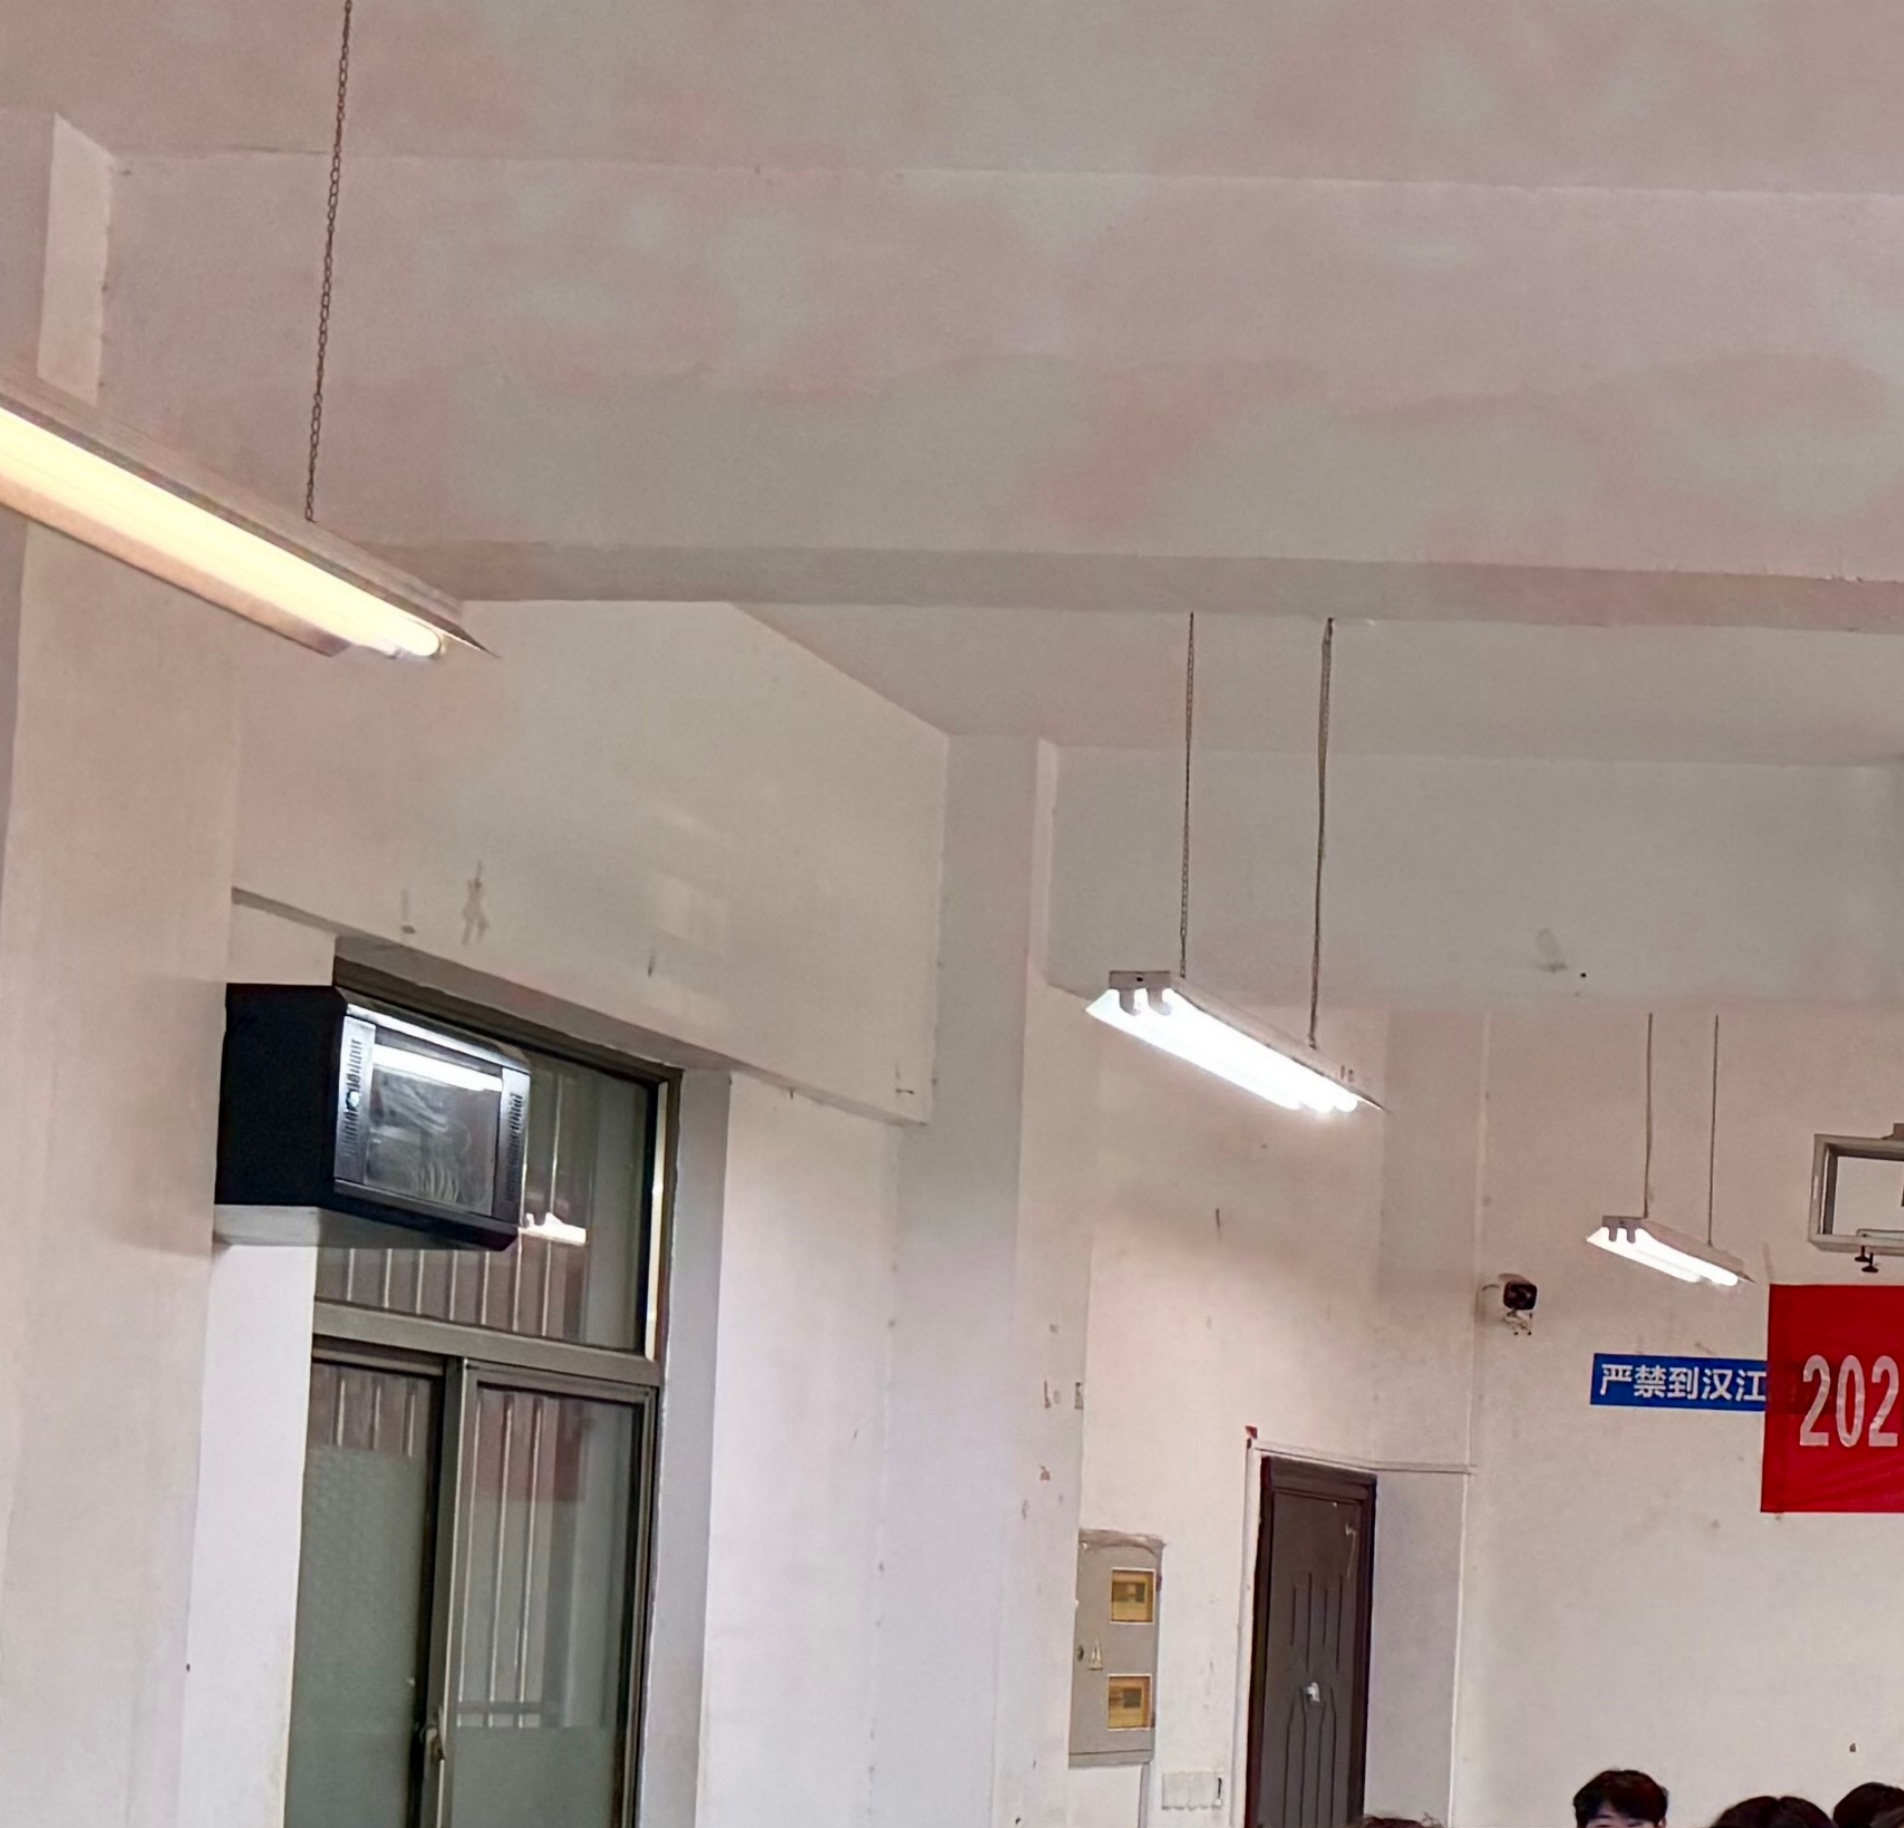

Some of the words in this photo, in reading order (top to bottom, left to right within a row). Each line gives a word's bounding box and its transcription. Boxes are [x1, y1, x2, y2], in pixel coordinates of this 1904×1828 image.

[1600, 1363, 1767, 1402] 严禁到汉江
